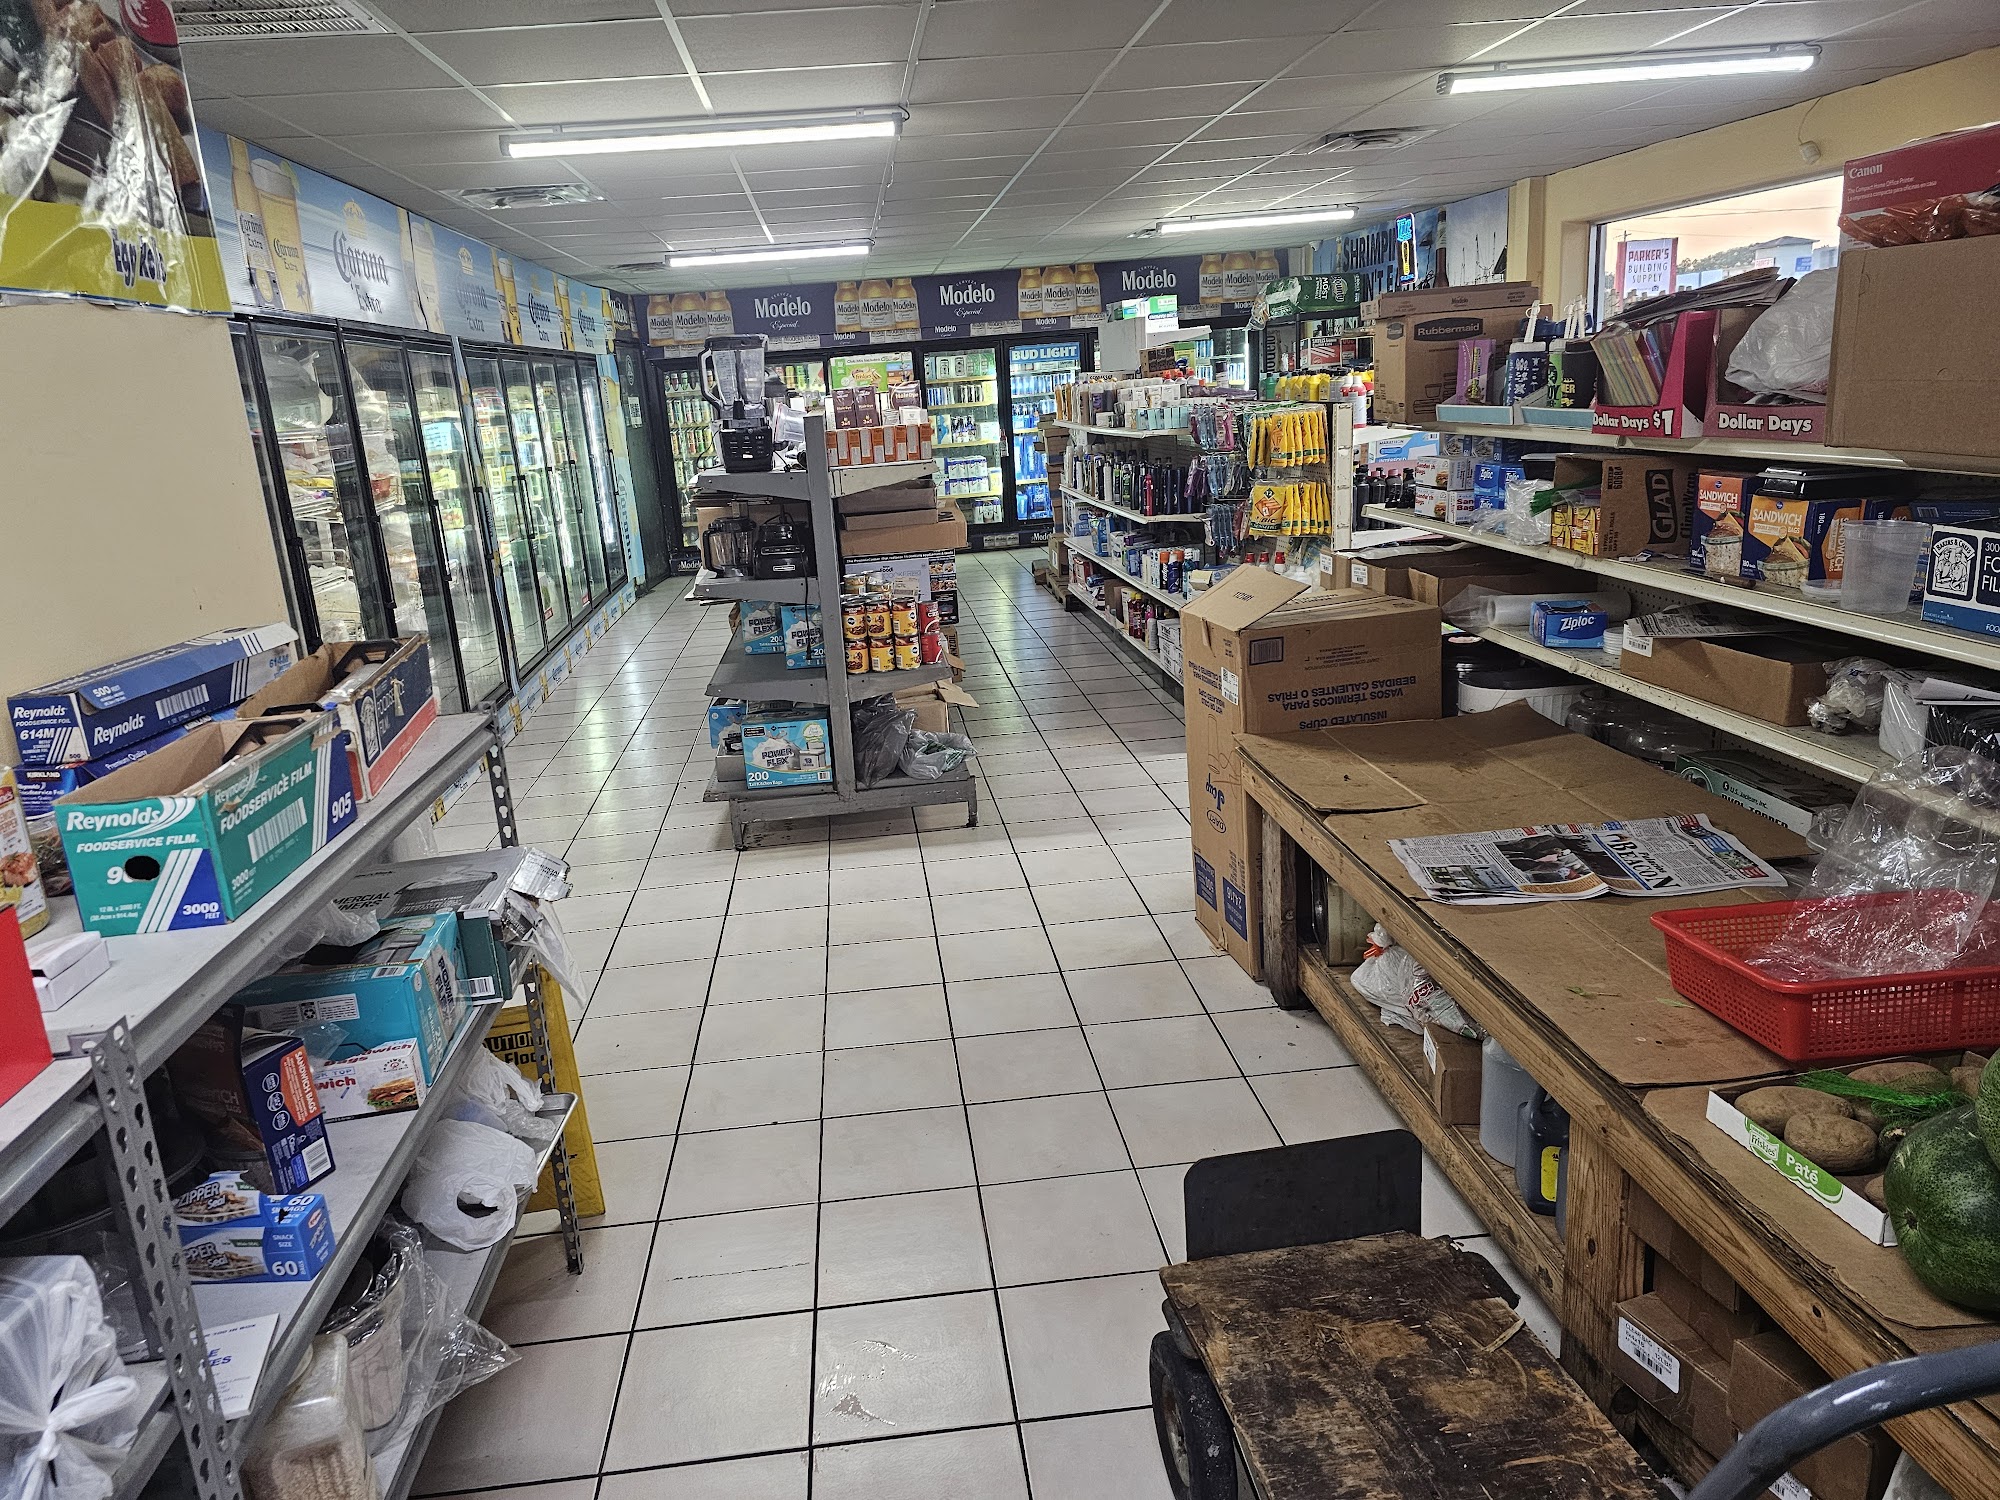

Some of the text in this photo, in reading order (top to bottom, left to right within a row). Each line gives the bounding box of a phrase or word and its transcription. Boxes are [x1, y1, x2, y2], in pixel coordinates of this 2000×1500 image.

[1848, 163, 1883, 179] Canon
[332, 230, 390, 286] Corona
[1628, 248, 1670, 263] PARKER'S
[1628, 262, 1668, 274] BUILDING
[1121, 268, 1178, 292] Modelo
[1632, 273, 1663, 284] SUPPLY
[351, 283, 383, 315] Extra
[939, 283, 996, 306] Modelo
[754, 295, 812, 319] Modelo
[934, 324, 957, 334] Modelo
[1035, 317, 1057, 326] Modelo
[833, 331, 856, 341] Modelo
[1417, 322, 1480, 337] Rubbermaid
[1011, 346, 1077, 362] BUD LIGHT
[1592, 409, 1674, 436] Dollar Days $1
[1718, 412, 1813, 436] Dollar Days
[1480, 468, 1494, 480] Ziploc
[1700, 489, 1738, 504] SANDWICH
[1651, 473, 1676, 539] GLAD
[1752, 508, 1802, 527] SANDWICH
[1818, 512, 1826, 524] 180
[1788, 525, 1800, 534] BAGS
[1935, 538, 1955, 551] BAKERS
[748, 616, 776, 627] POWER
[1560, 615, 1596, 632] Ziploc
[753, 624, 774, 635] FLEX
[769, 635, 783, 643] 200
[92, 686, 111, 698] 500
[1267, 675, 1417, 703] BEBIDAS CALIENTES O FRÍAS
[1281, 687, 1404, 712] VASOS TÉRMICOS PARA
[13, 704, 68, 721] Reynolds
[1298, 710, 1388, 730] INSULATED CUPS
[15, 717, 71, 727] FOODSERVICE FOIL
[94, 713, 146, 746] Reynolds
[20, 727, 55, 741] 614M
[762, 747, 793, 760] POWER
[766, 756, 790, 768] FLEX
[27, 771, 61, 779] KIRKLAND
[748, 771, 770, 782] 200
[220, 760, 314, 836] FOODSERVICE FILM
[331, 791, 352, 824] 905
[66, 806, 162, 832] Reynolds
[1208, 813, 1224, 830] DART
[76, 833, 198, 854] FOODSERVICE FILM
[1607, 840, 1682, 889] BEACON
[231, 868, 250, 892] 3000
[182, 902, 220, 916] 3000
[337, 899, 381, 912] INERS
[205, 911, 221, 921] FEET
[1750, 1134, 1777, 1157] Friskies
[1785, 1152, 1819, 1186] Paté
[176, 1182, 221, 1208] ZIPPER
[287, 1194, 316, 1207] 60
[207, 1197, 226, 1210] Seal
[272, 1233, 295, 1242] SNACK
[277, 1241, 293, 1249] SIZE
[207, 1254, 229, 1269] Seal
[271, 1259, 299, 1277] 60
